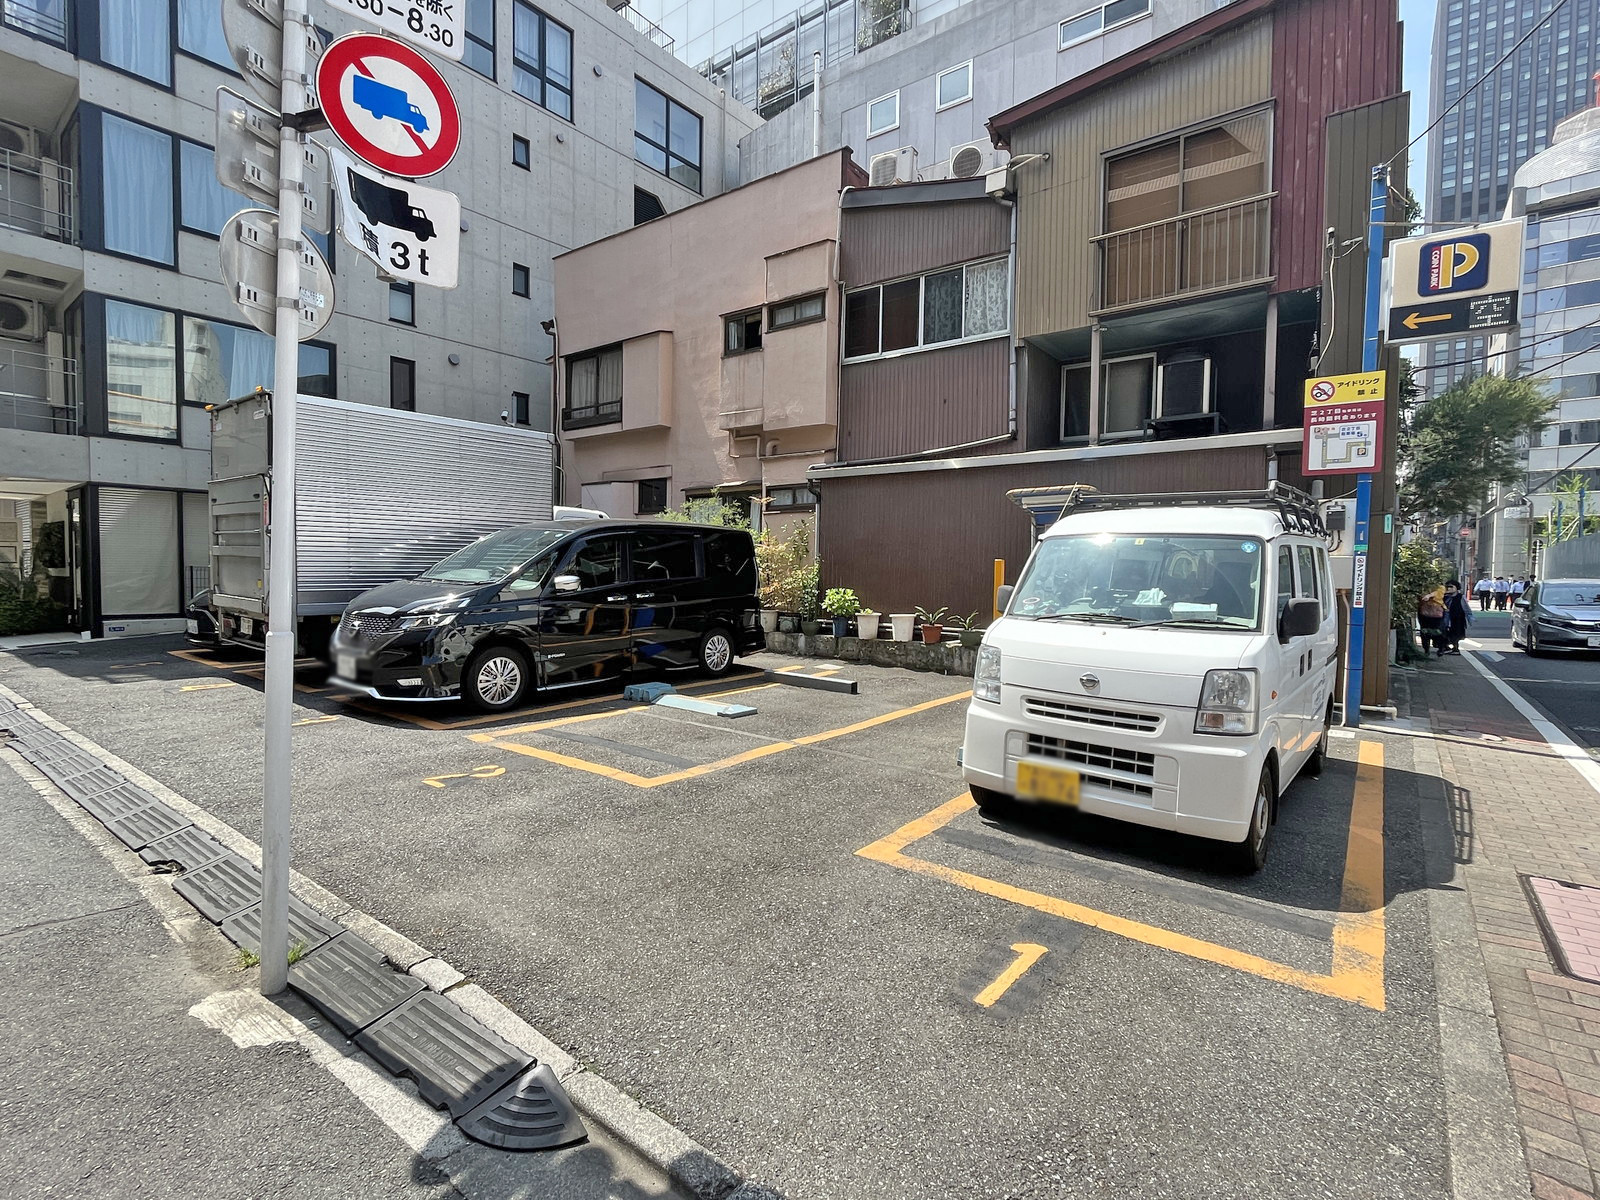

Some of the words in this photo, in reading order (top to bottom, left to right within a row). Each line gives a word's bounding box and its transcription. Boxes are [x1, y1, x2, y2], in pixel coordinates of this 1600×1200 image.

[1431, 250, 1440, 268] COIN
[1430, 268, 1439, 288] PARK
[1337, 378, 1380, 388] アイドリング
[973, 943, 1049, 1008] 1
